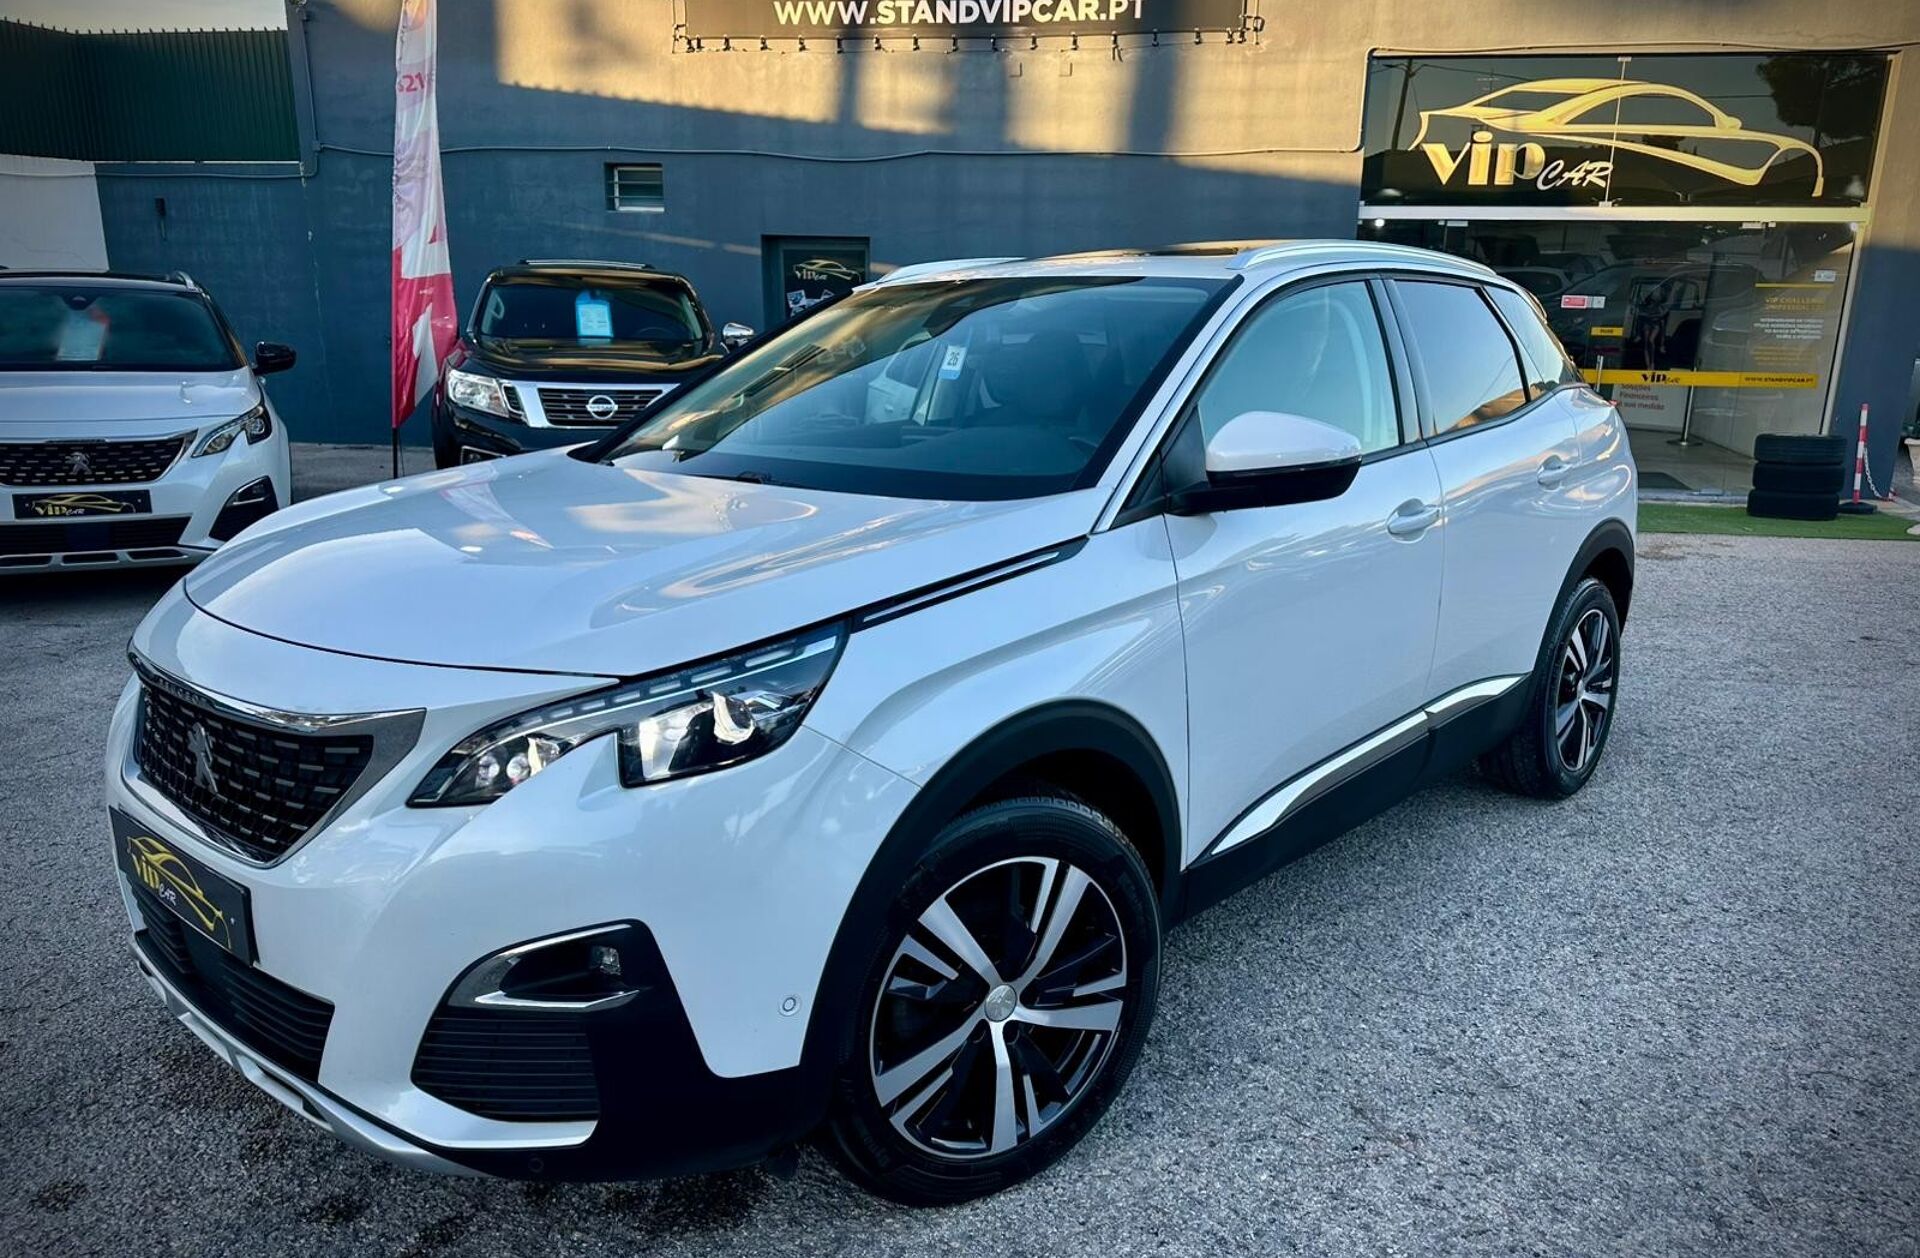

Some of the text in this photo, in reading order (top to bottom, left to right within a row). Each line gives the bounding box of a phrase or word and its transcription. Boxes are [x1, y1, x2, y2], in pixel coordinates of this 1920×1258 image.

[773, 0, 1143, 26] WWW.STANDVIPCAR.PT
[1536, 159, 1613, 191] CAR
[947, 351, 960, 366] 26
